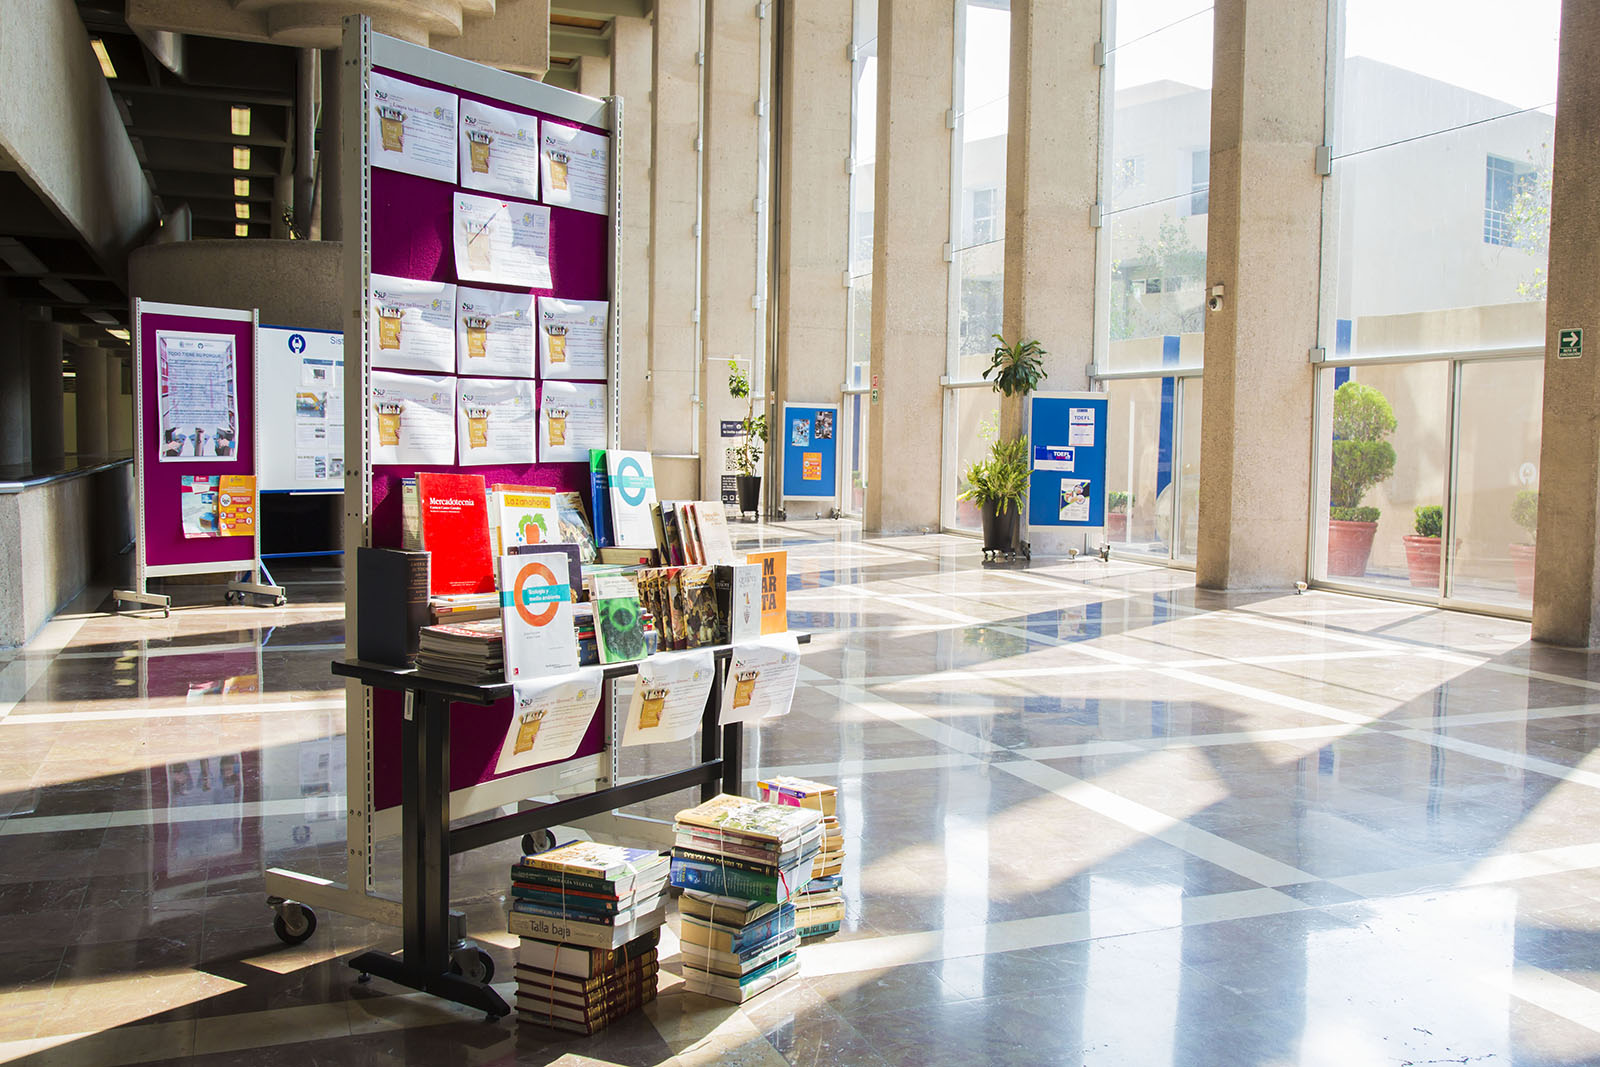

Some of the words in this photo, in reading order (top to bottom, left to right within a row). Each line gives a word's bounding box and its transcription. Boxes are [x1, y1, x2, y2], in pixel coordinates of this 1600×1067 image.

[429, 497, 475, 506] Mercadotecnia
[529, 919, 549, 934] Talla
[552, 923, 571, 940] baja
